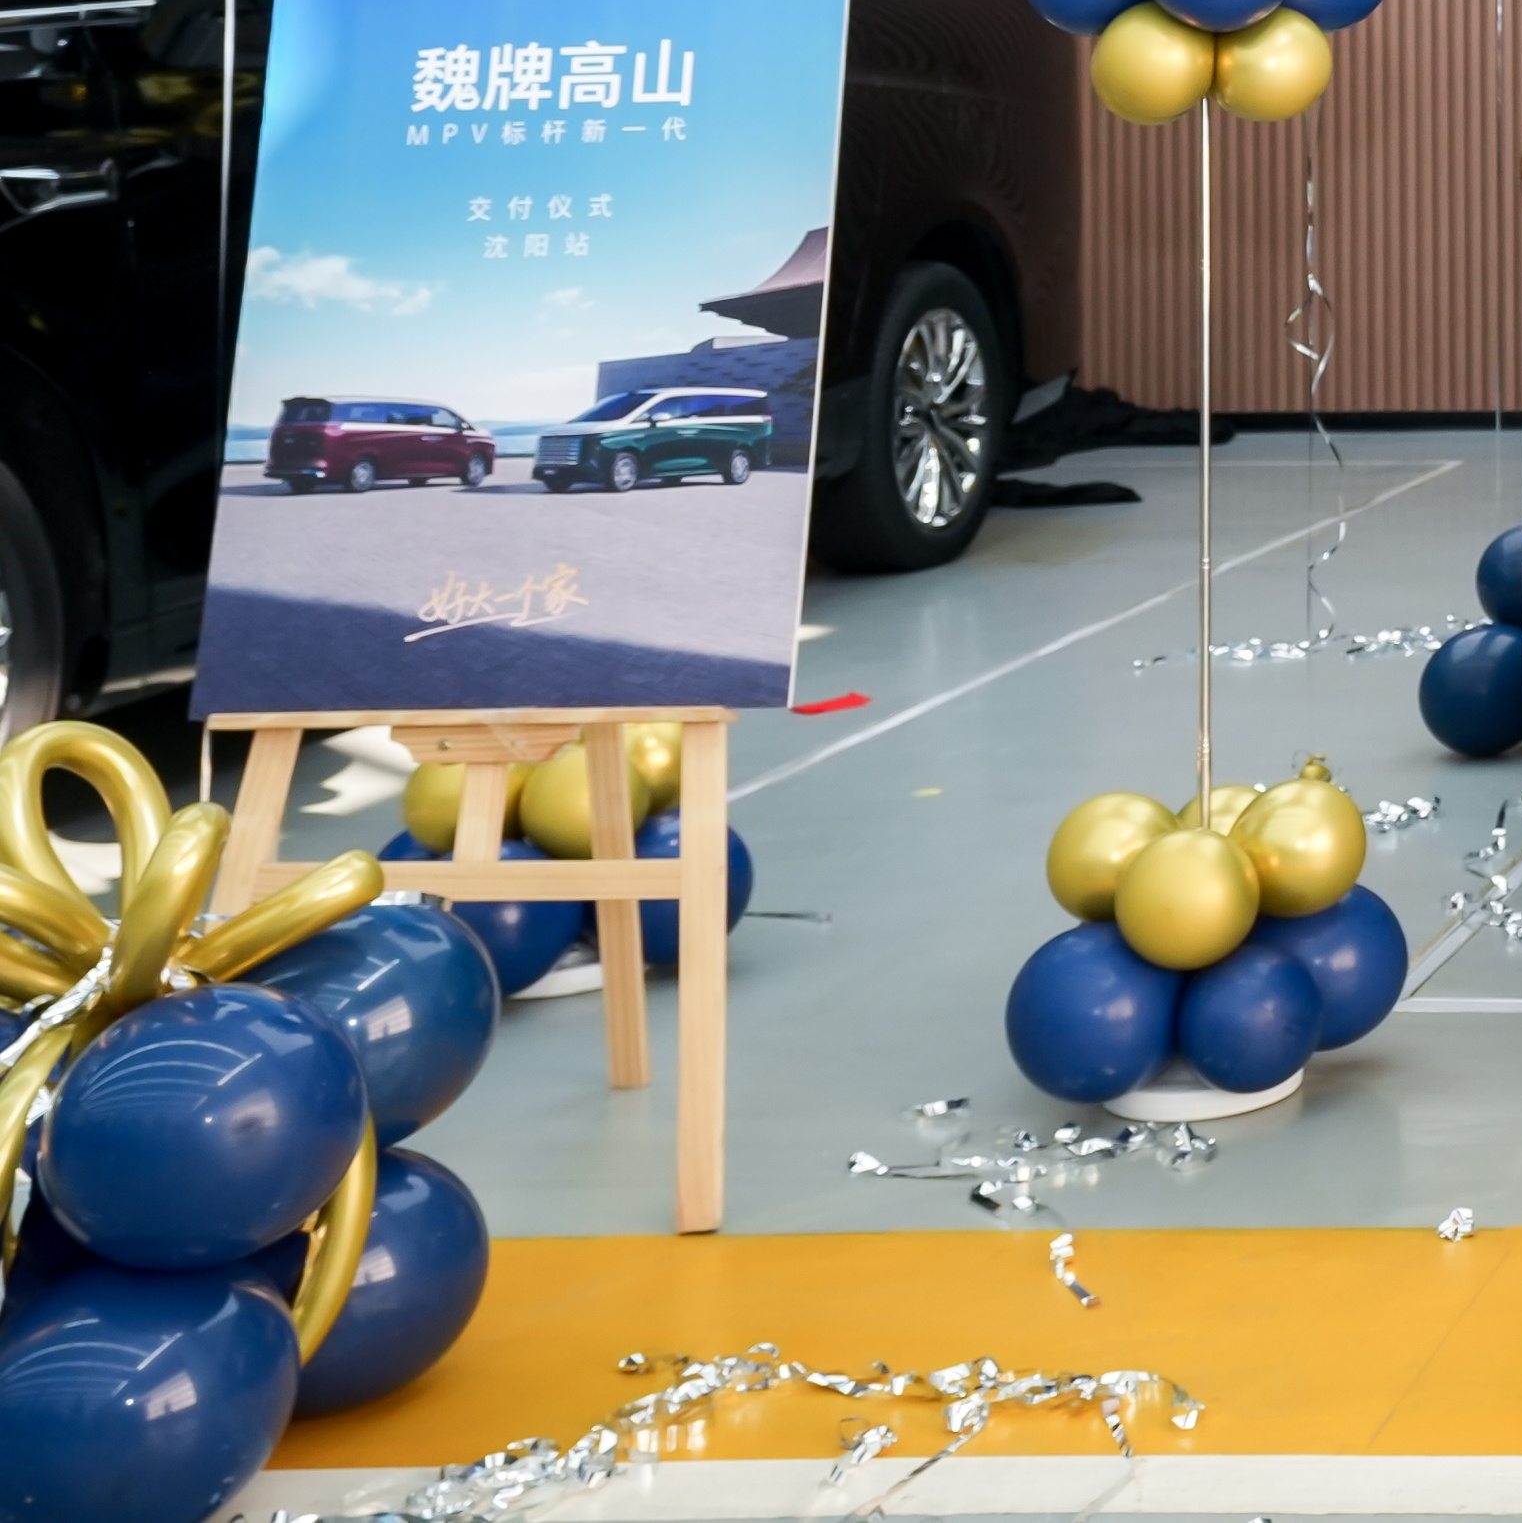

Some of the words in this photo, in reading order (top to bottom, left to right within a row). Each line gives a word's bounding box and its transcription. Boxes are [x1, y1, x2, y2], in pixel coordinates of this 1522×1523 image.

[410, 39, 695, 112] 魏牌高山
[406, 116, 688, 146] MPV标杆新一代
[467, 193, 614, 222] 交付仪式
[483, 232, 591, 259] 沈阳站
